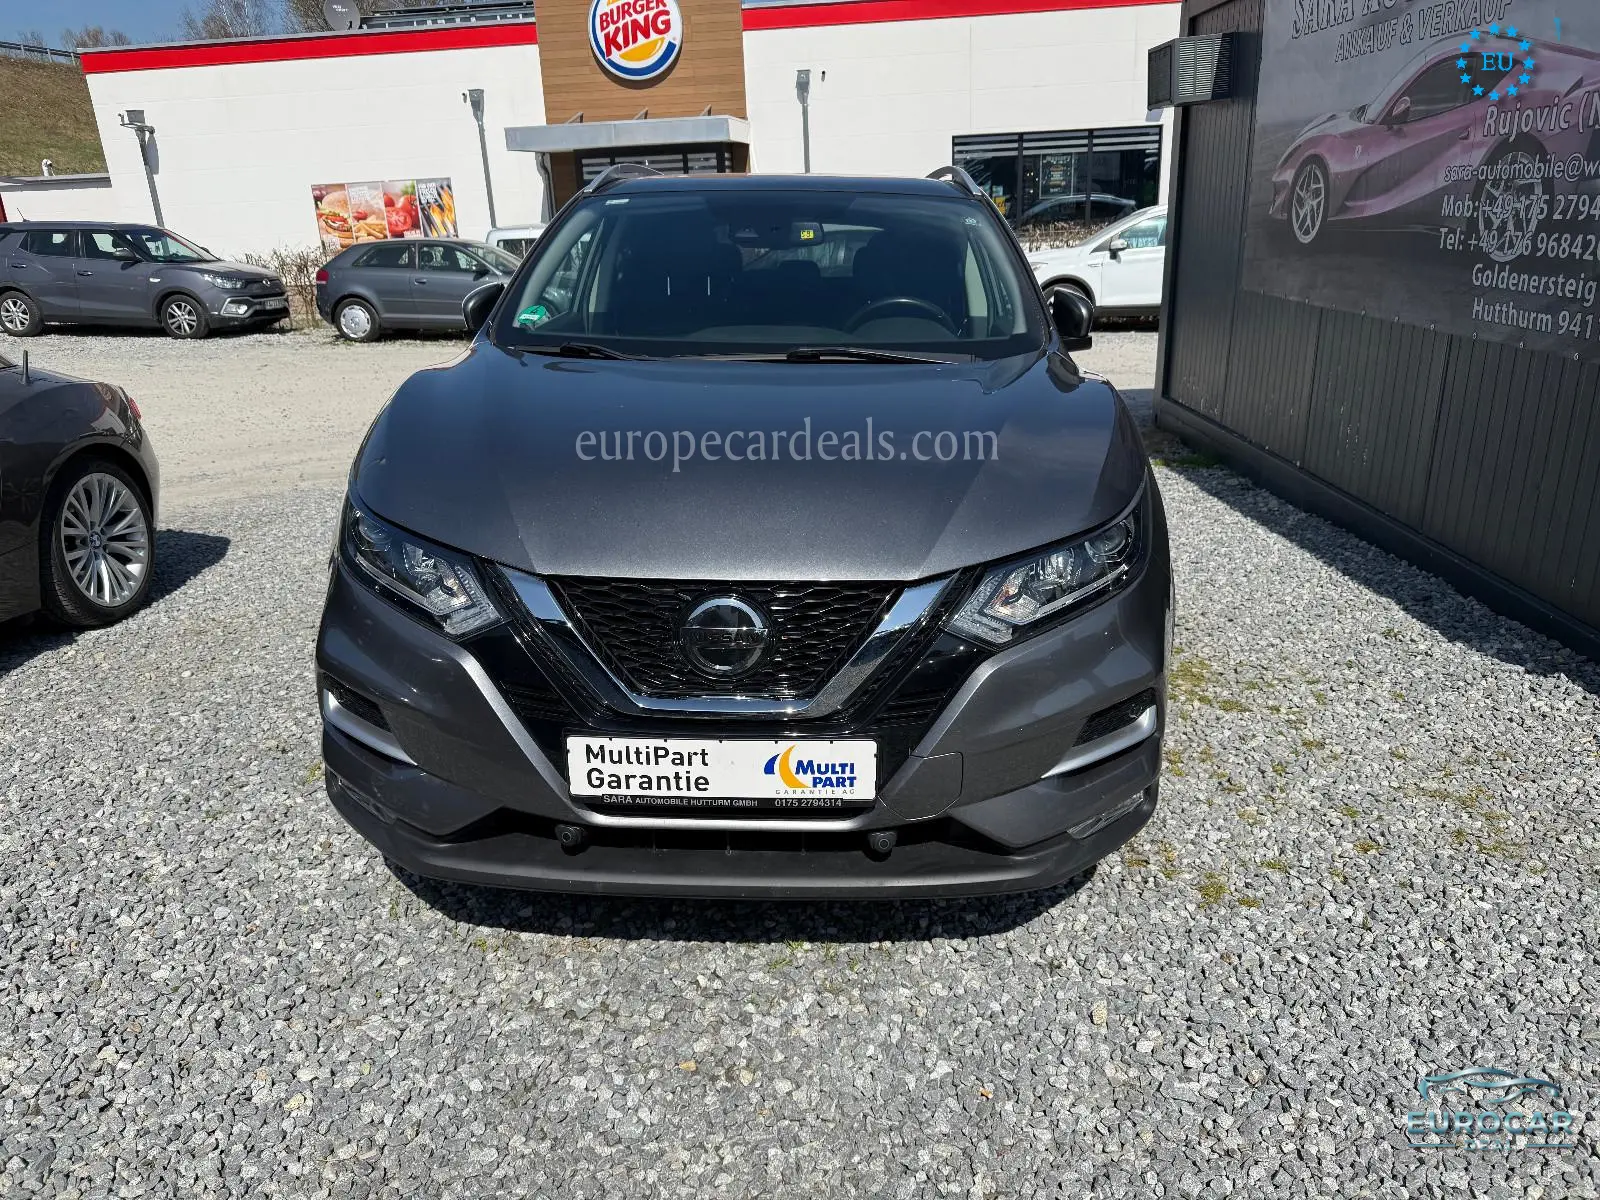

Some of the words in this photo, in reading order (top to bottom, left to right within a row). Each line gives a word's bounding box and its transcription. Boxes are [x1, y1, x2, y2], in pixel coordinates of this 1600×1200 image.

[599, 0, 667, 32] BURGER
[1335, 17, 1399, 62] ANKAUF
[1399, 13, 1413, 45] &
[1418, 0, 1512, 40] VERKAUF
[604, 9, 671, 58] KING
[1483, 96, 1573, 142] Rujovic
[1444, 152, 1600, 182] sara-automobile@w
[1441, 193, 1479, 218] Mob:
[1482, 194, 1514, 219] +49
[1519, 194, 1549, 220] 175
[1439, 227, 1464, 251] Tel:
[1468, 229, 1498, 253] +49
[1503, 229, 1532, 256] 176
[1536, 232, 1600, 261] 96842
[1471, 263, 1598, 308] Goldenersteig
[1471, 297, 1552, 333] Hutthurm
[1558, 310, 1600, 340] 941
[585, 744, 709, 767] MultiPart
[586, 767, 710, 792] Garantie
[812, 776, 857, 788] PART
[603, 794, 633, 804] SARA
[635, 797, 689, 806] AUTOMOBILE
[690, 799, 731, 807] HUTTURM
[733, 799, 758, 808] GMBH
[775, 798, 799, 807] 0175
[801, 798, 842, 808] 2794314
